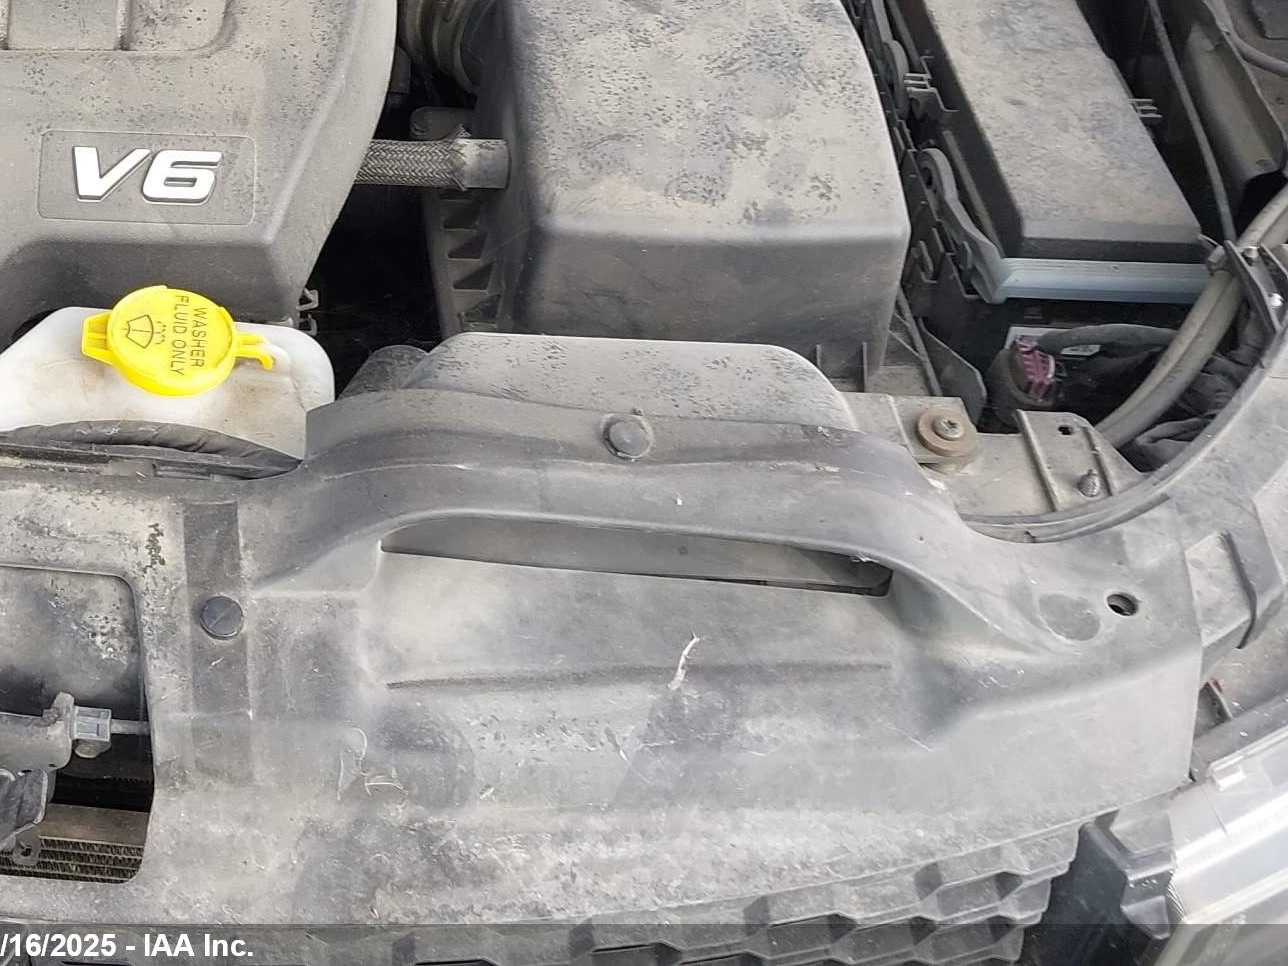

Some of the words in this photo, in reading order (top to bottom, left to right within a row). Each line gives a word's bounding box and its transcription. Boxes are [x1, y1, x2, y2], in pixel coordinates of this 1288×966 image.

[73, 146, 223, 203] V6
[173, 295, 190, 334] FLUID
[190, 307, 208, 367] WASHER
[170, 339, 187, 375] ONLY
